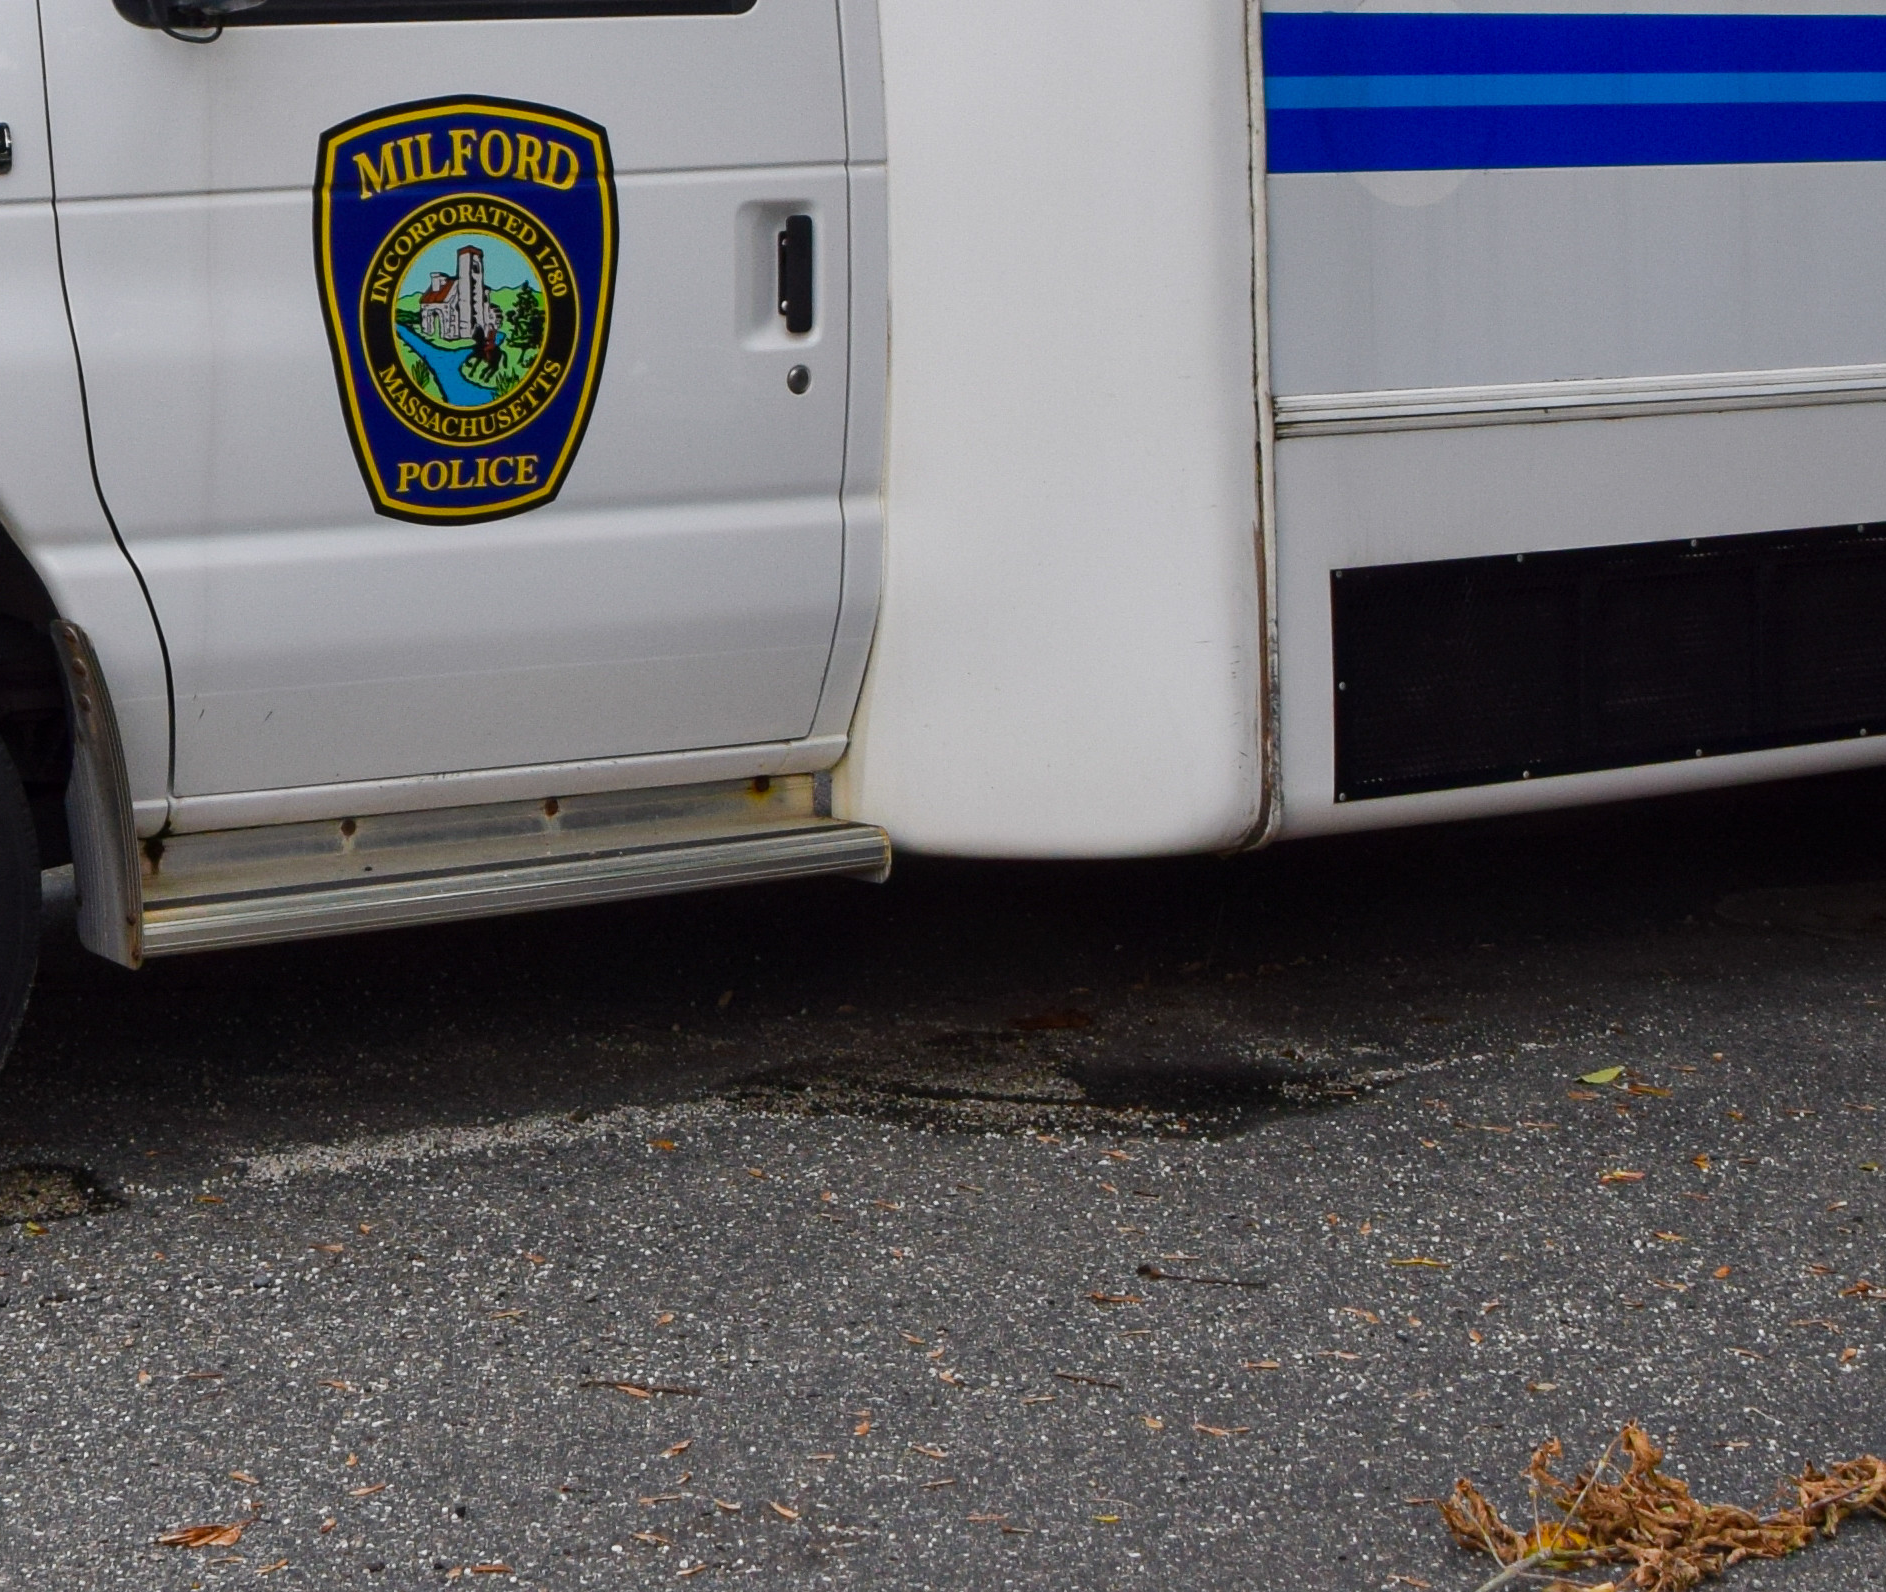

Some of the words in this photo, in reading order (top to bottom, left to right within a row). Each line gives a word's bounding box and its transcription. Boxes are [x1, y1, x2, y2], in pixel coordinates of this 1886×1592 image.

[352, 129, 579, 200] MILFORD
[371, 204, 539, 304] INCORPORATED
[535, 246, 568, 297] 1780
[378, 359, 562, 437] MASSACHUSETTS
[395, 454, 539, 493] POLICE
